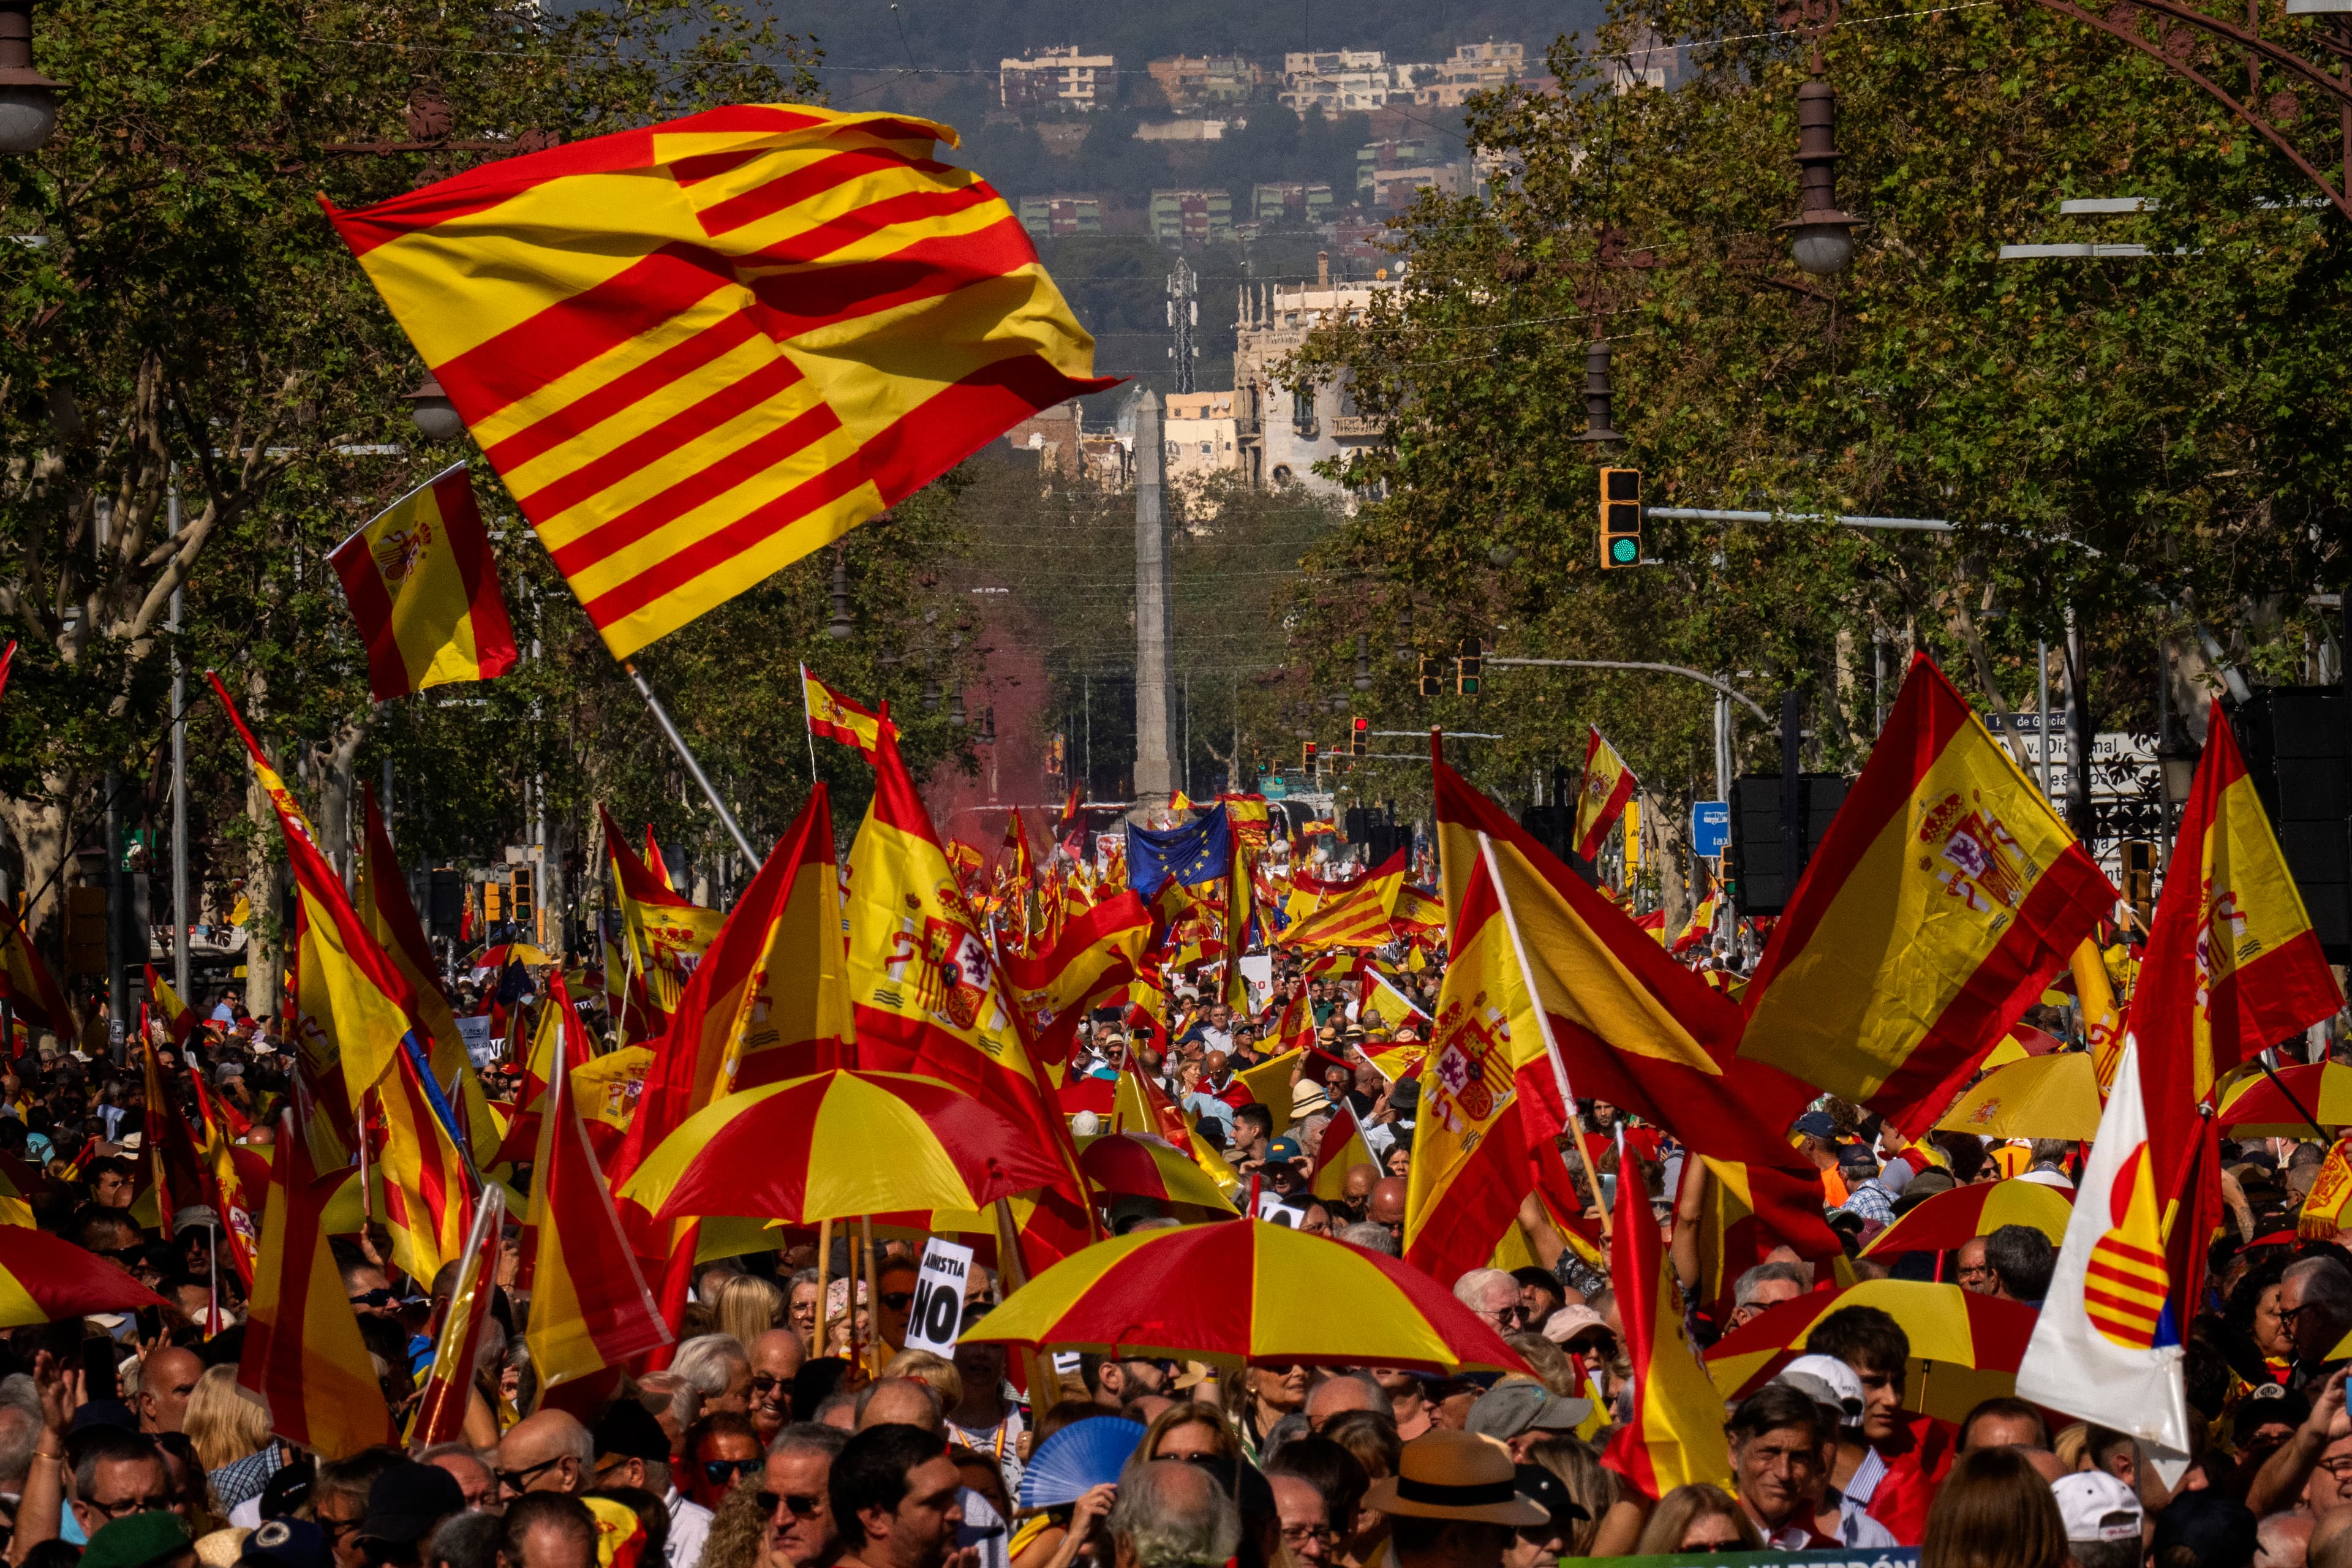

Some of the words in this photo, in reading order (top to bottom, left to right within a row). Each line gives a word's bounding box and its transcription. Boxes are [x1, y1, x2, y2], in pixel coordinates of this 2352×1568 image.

[2017, 717, 2030, 726] de
[1713, 837, 1728, 845] tax
[908, 1278, 959, 1344] NO
